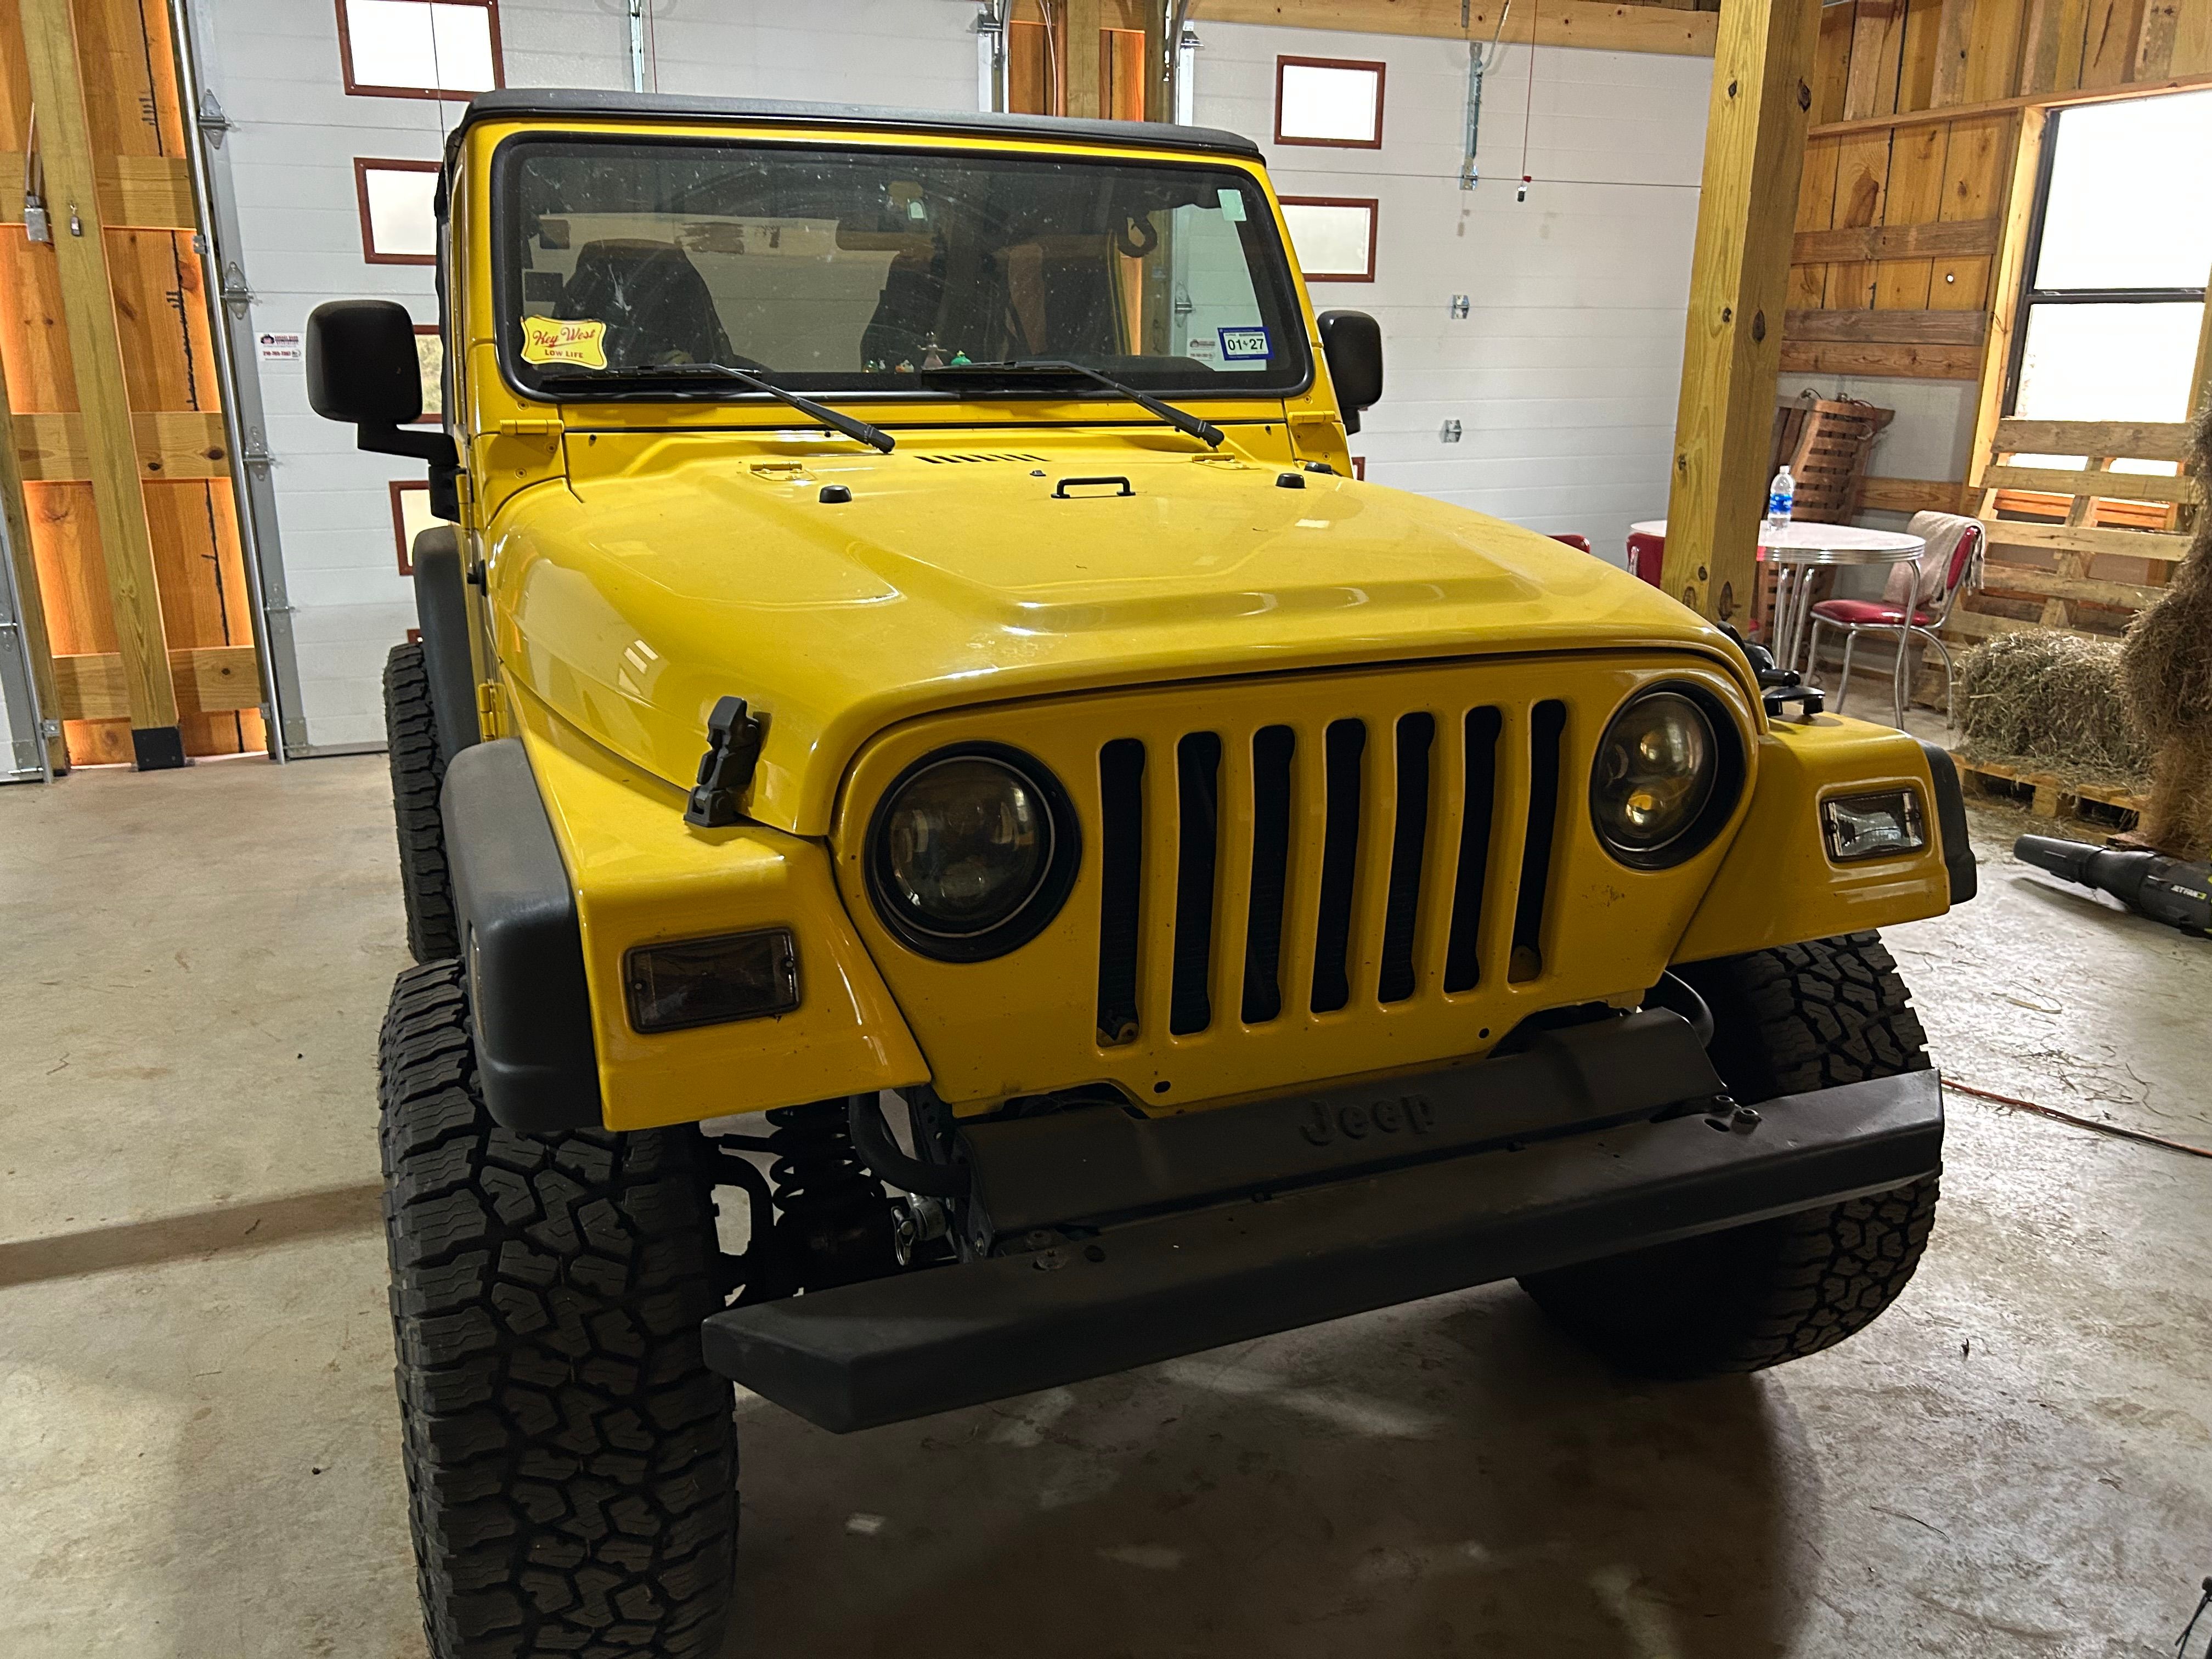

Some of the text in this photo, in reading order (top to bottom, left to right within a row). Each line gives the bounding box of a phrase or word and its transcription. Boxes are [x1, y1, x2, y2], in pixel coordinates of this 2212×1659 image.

[532, 327, 596, 347] Key West
[1228, 339, 1243, 351] 01
[1249, 338, 1264, 350] 27
[1299, 1093, 1434, 1147] Jeep
